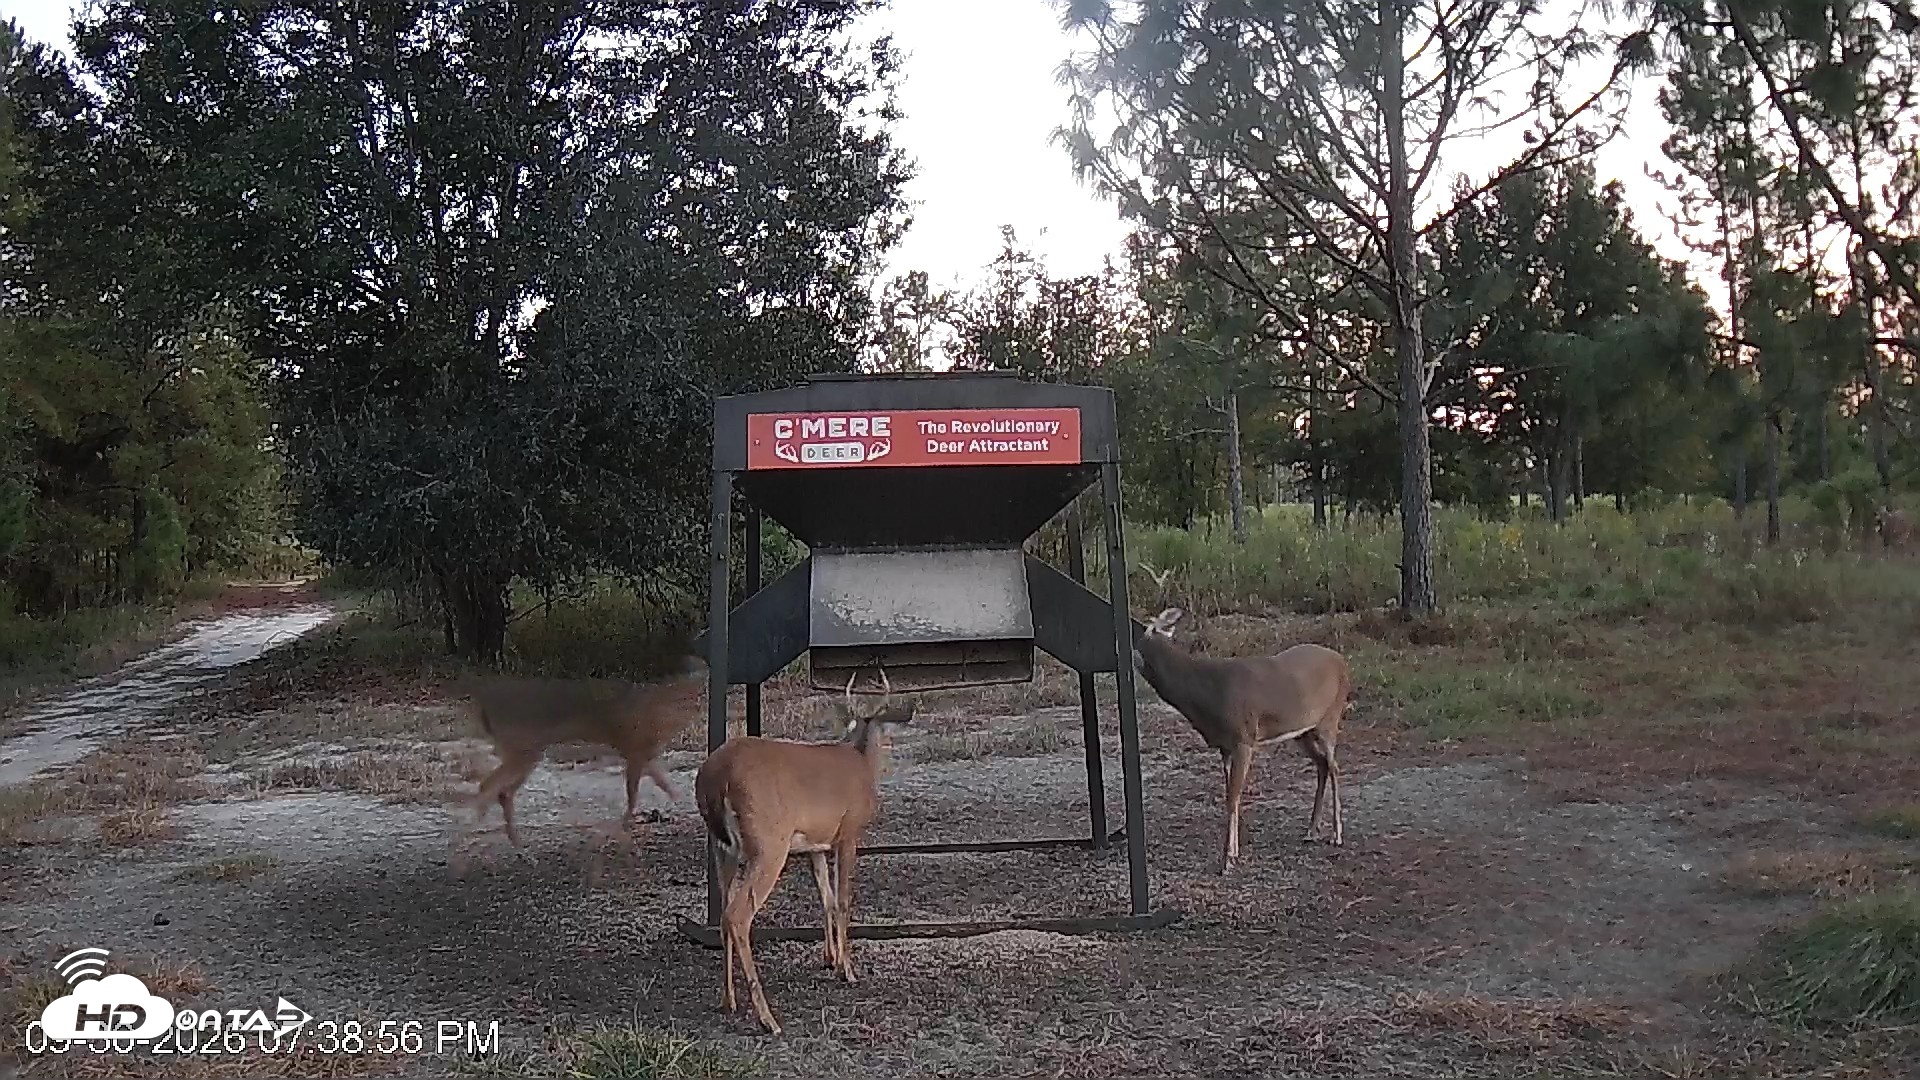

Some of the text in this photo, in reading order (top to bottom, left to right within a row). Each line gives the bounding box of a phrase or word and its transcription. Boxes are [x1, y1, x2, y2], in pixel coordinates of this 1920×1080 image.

[774, 416, 891, 439] C'MERE
[917, 418, 1060, 435] The Revolutionary
[807, 447, 860, 459] DEER
[927, 437, 1049, 453] Deer Attractant
